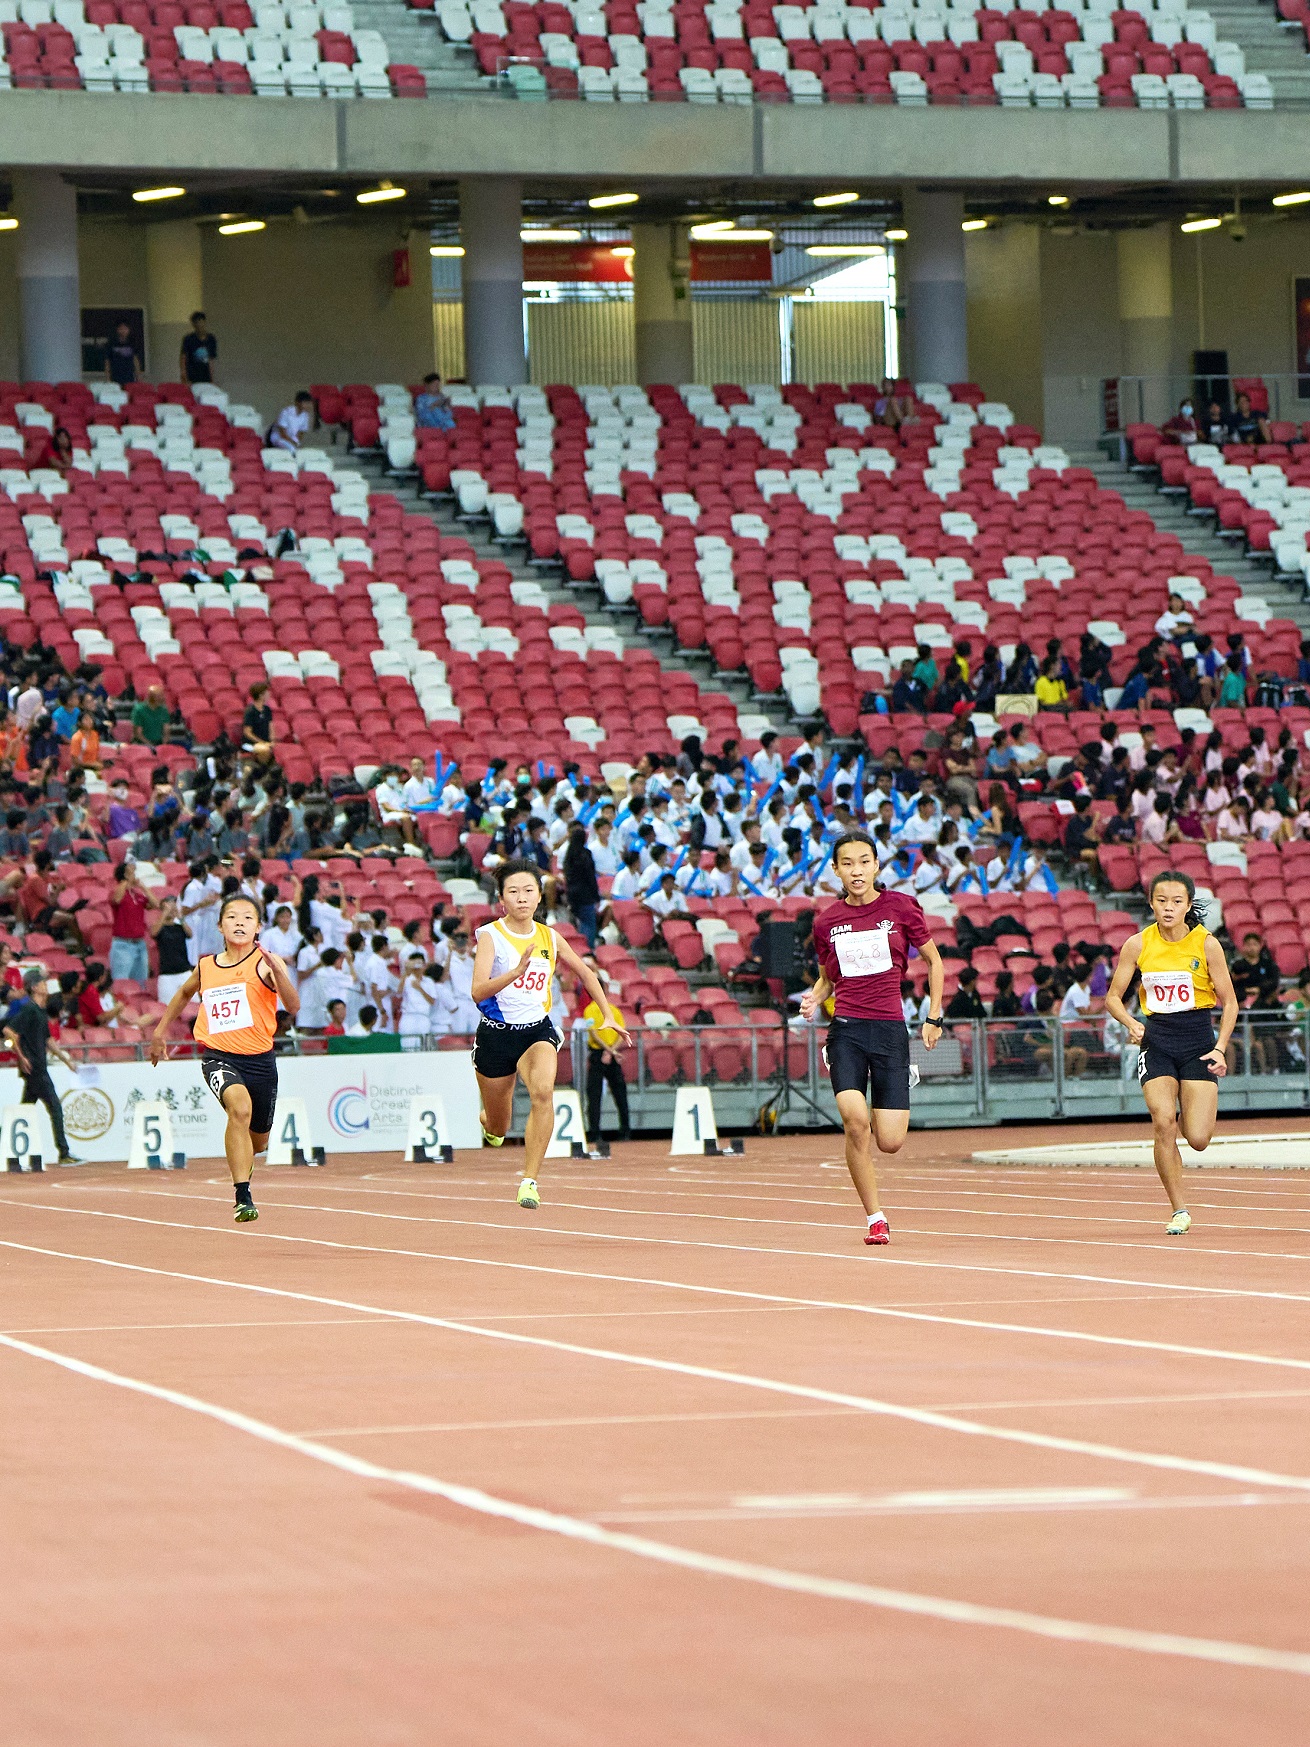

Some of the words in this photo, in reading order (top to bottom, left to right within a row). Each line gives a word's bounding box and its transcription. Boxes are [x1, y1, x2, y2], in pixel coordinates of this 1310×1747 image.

[513, 972, 546, 991] 358
[1154, 984, 1190, 1003] 076
[211, 999, 240, 1020] 457
[481, 1016, 506, 1030] PRO
[369, 1084, 424, 1098] Distinct
[178, 1114, 208, 1124] TONG
[371, 1112, 403, 1124] Arts
[555, 1104, 573, 1141] 2
[687, 1103, 701, 1141] 1
[10, 1118, 30, 1158] 6
[143, 1115, 162, 1153] 5
[281, 1113, 300, 1149] 4
[420, 1110, 438, 1148] 3
